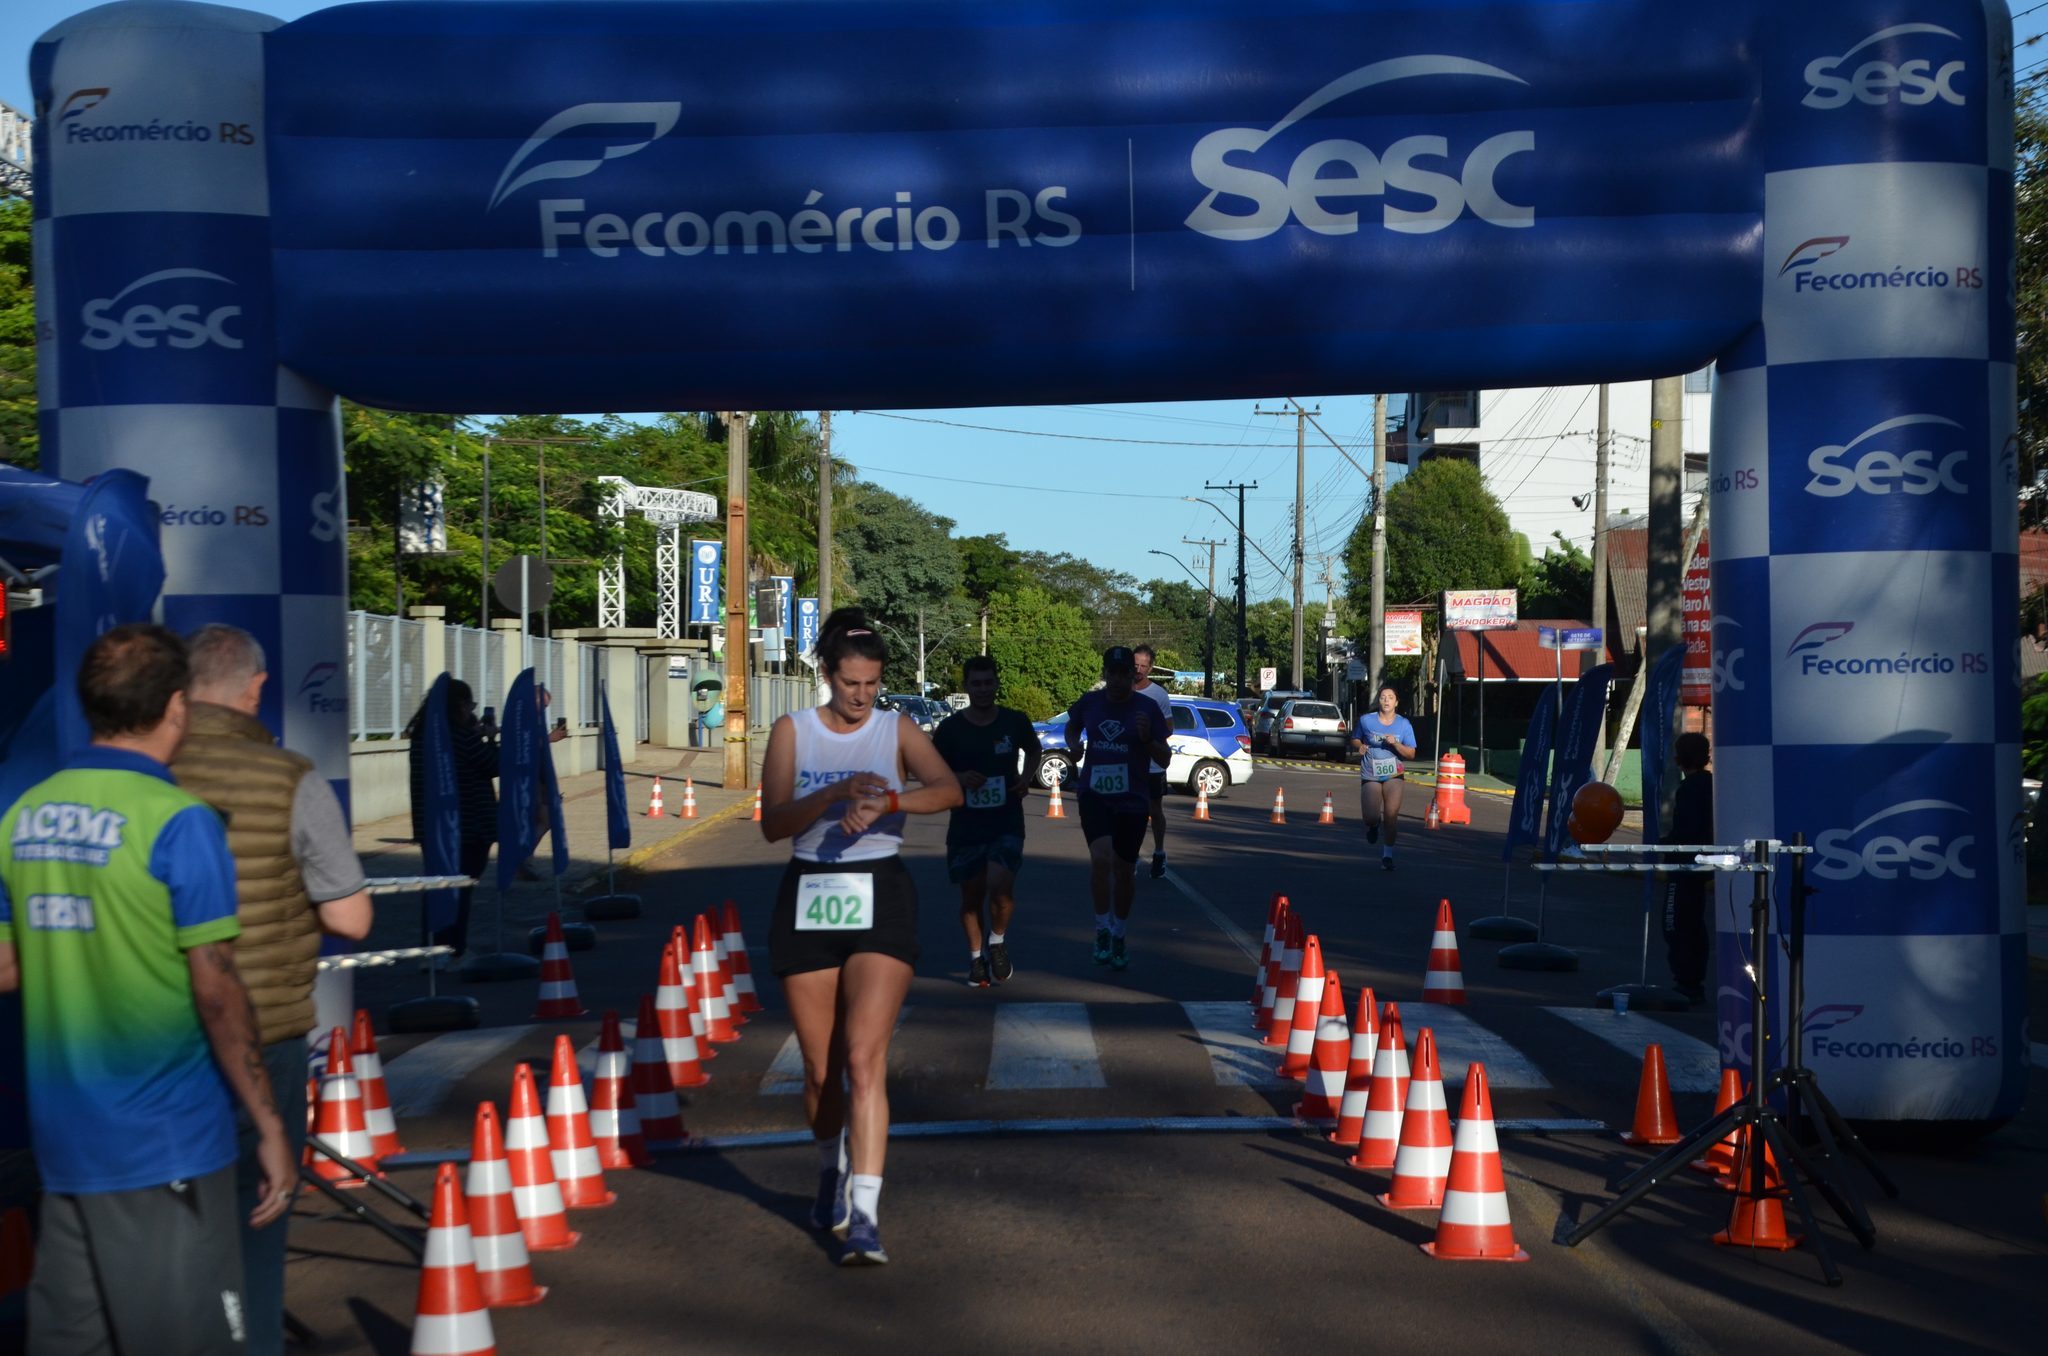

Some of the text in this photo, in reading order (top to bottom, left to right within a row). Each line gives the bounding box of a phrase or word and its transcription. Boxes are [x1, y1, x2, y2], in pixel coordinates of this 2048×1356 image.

[1801, 55, 1966, 110] Sesc
[67, 119, 255, 145] Fecomércio RS
[1184, 126, 1535, 242] Sesc
[540, 186, 1082, 258] Fecomércio RS
[1795, 265, 1983, 293] Fecomércio RS
[81, 298, 243, 350] Sesc
[1735, 468, 1759, 491] RS
[1804, 445, 1968, 497] Sesc
[159, 505, 269, 526] ércio RS
[698, 567, 715, 620] URI
[1802, 651, 1988, 675] Fecomércio RS
[1094, 775, 1124, 791] 403
[1376, 764, 1394, 775] 360
[971, 788, 1001, 805] 335
[1812, 828, 1976, 880] Sesc
[806, 895, 863, 924] 402
[1812, 1036, 1998, 1059] Fecomércio RS
